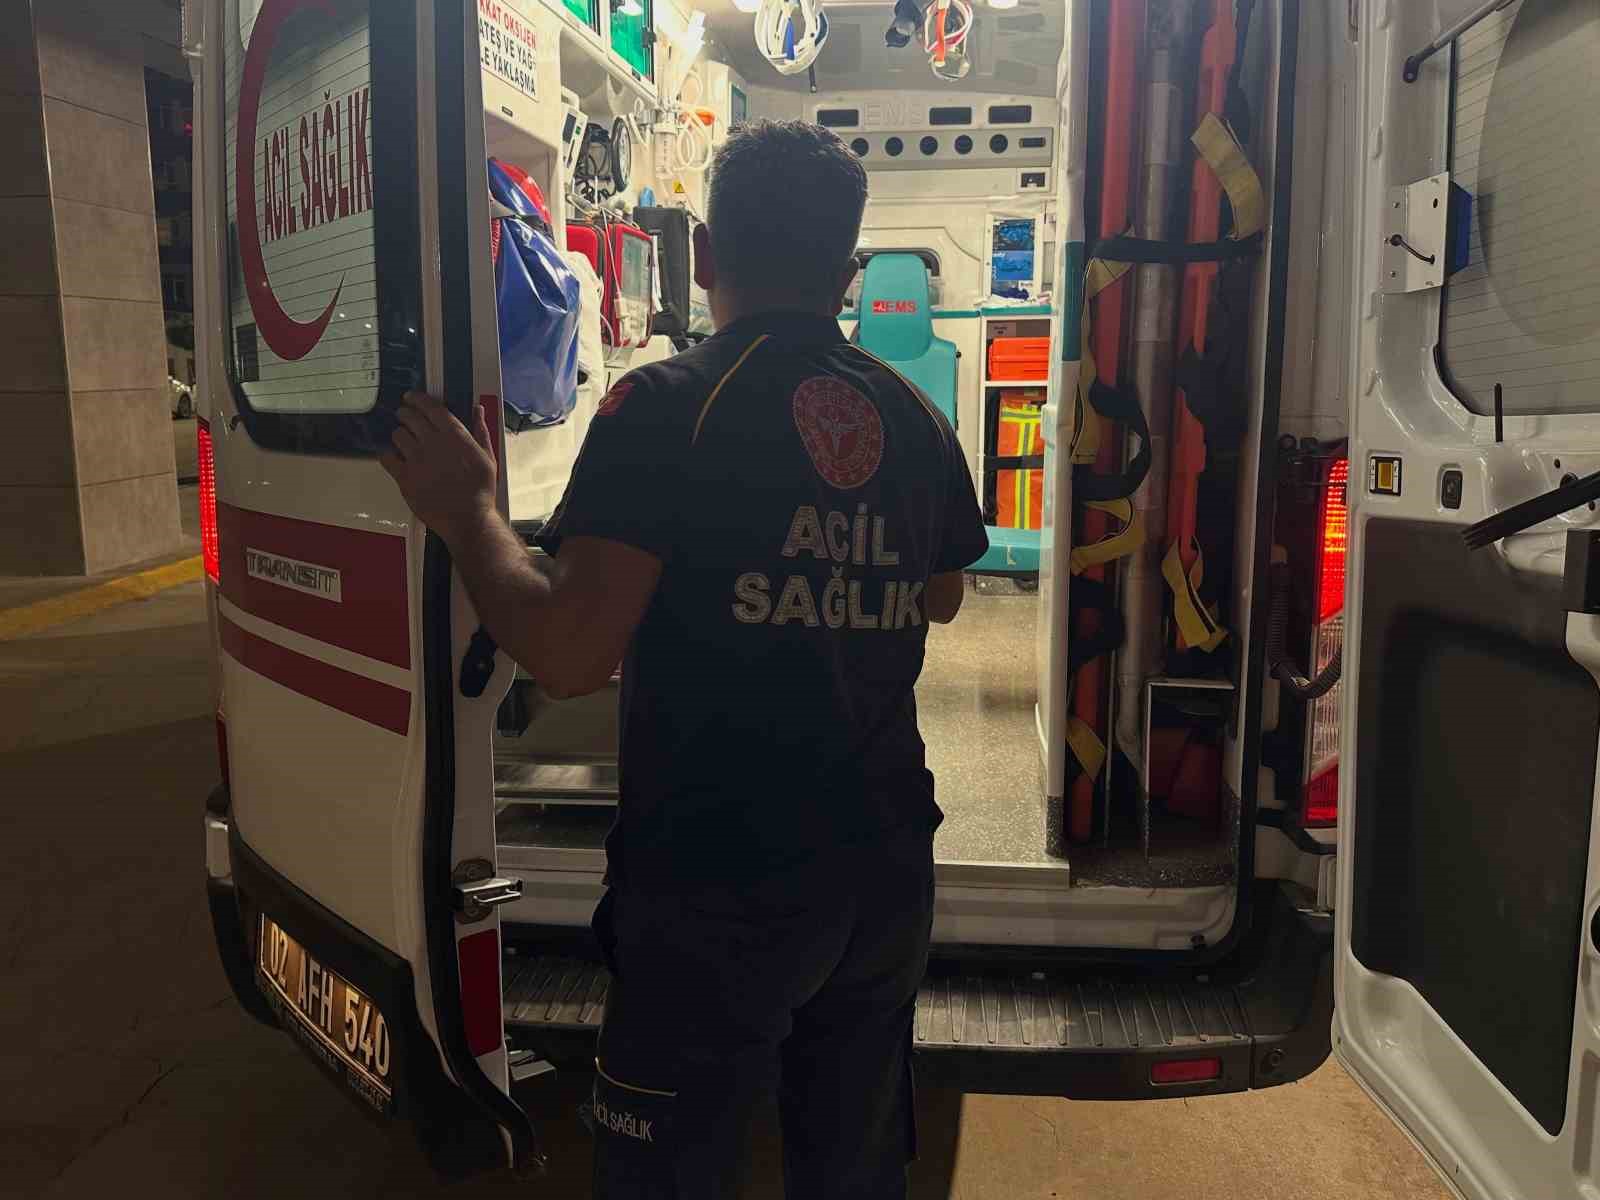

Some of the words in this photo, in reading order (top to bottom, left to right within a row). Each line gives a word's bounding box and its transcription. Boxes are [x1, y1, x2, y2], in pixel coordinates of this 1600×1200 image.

[503, 33, 515, 58] VE
[300, 87, 373, 231] SAĞLIK
[731, 563, 925, 631] SAĞLIK
[270, 922, 289, 988] 02
[298, 950, 334, 1034] AFH
[344, 985, 390, 1077] 540
[610, 1111, 653, 1142] SAĞLIK
